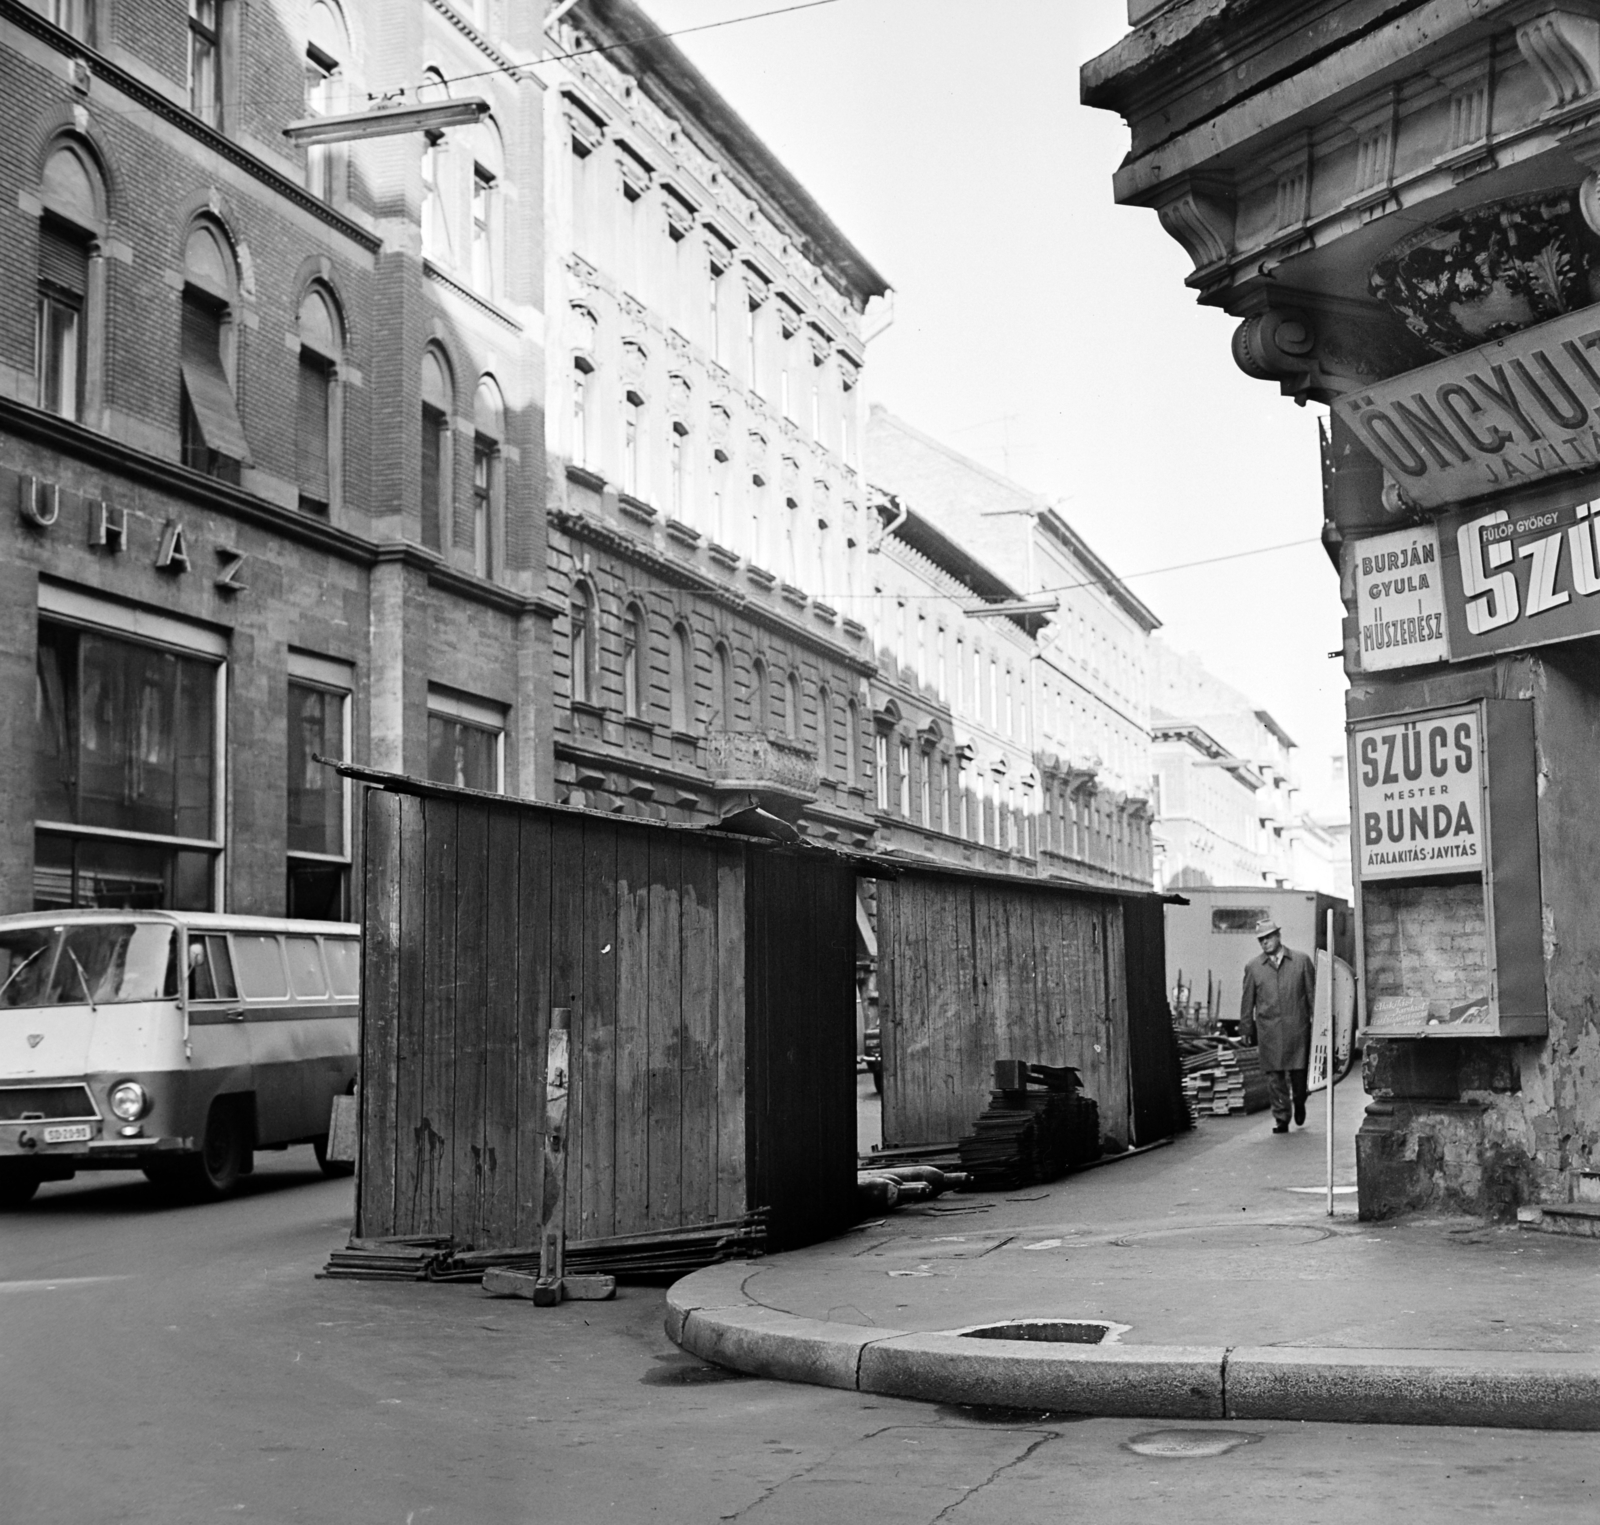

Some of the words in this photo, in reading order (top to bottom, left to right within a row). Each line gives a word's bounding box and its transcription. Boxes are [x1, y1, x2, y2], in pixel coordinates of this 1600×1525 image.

[1516, 511, 1559, 533] GYÖRGY
[1361, 540, 1435, 576] BURJÁN
[1368, 573, 1430, 600] GYULA
[1384, 784, 1450, 802] MESTER
[1364, 801, 1475, 846] BUNDA
